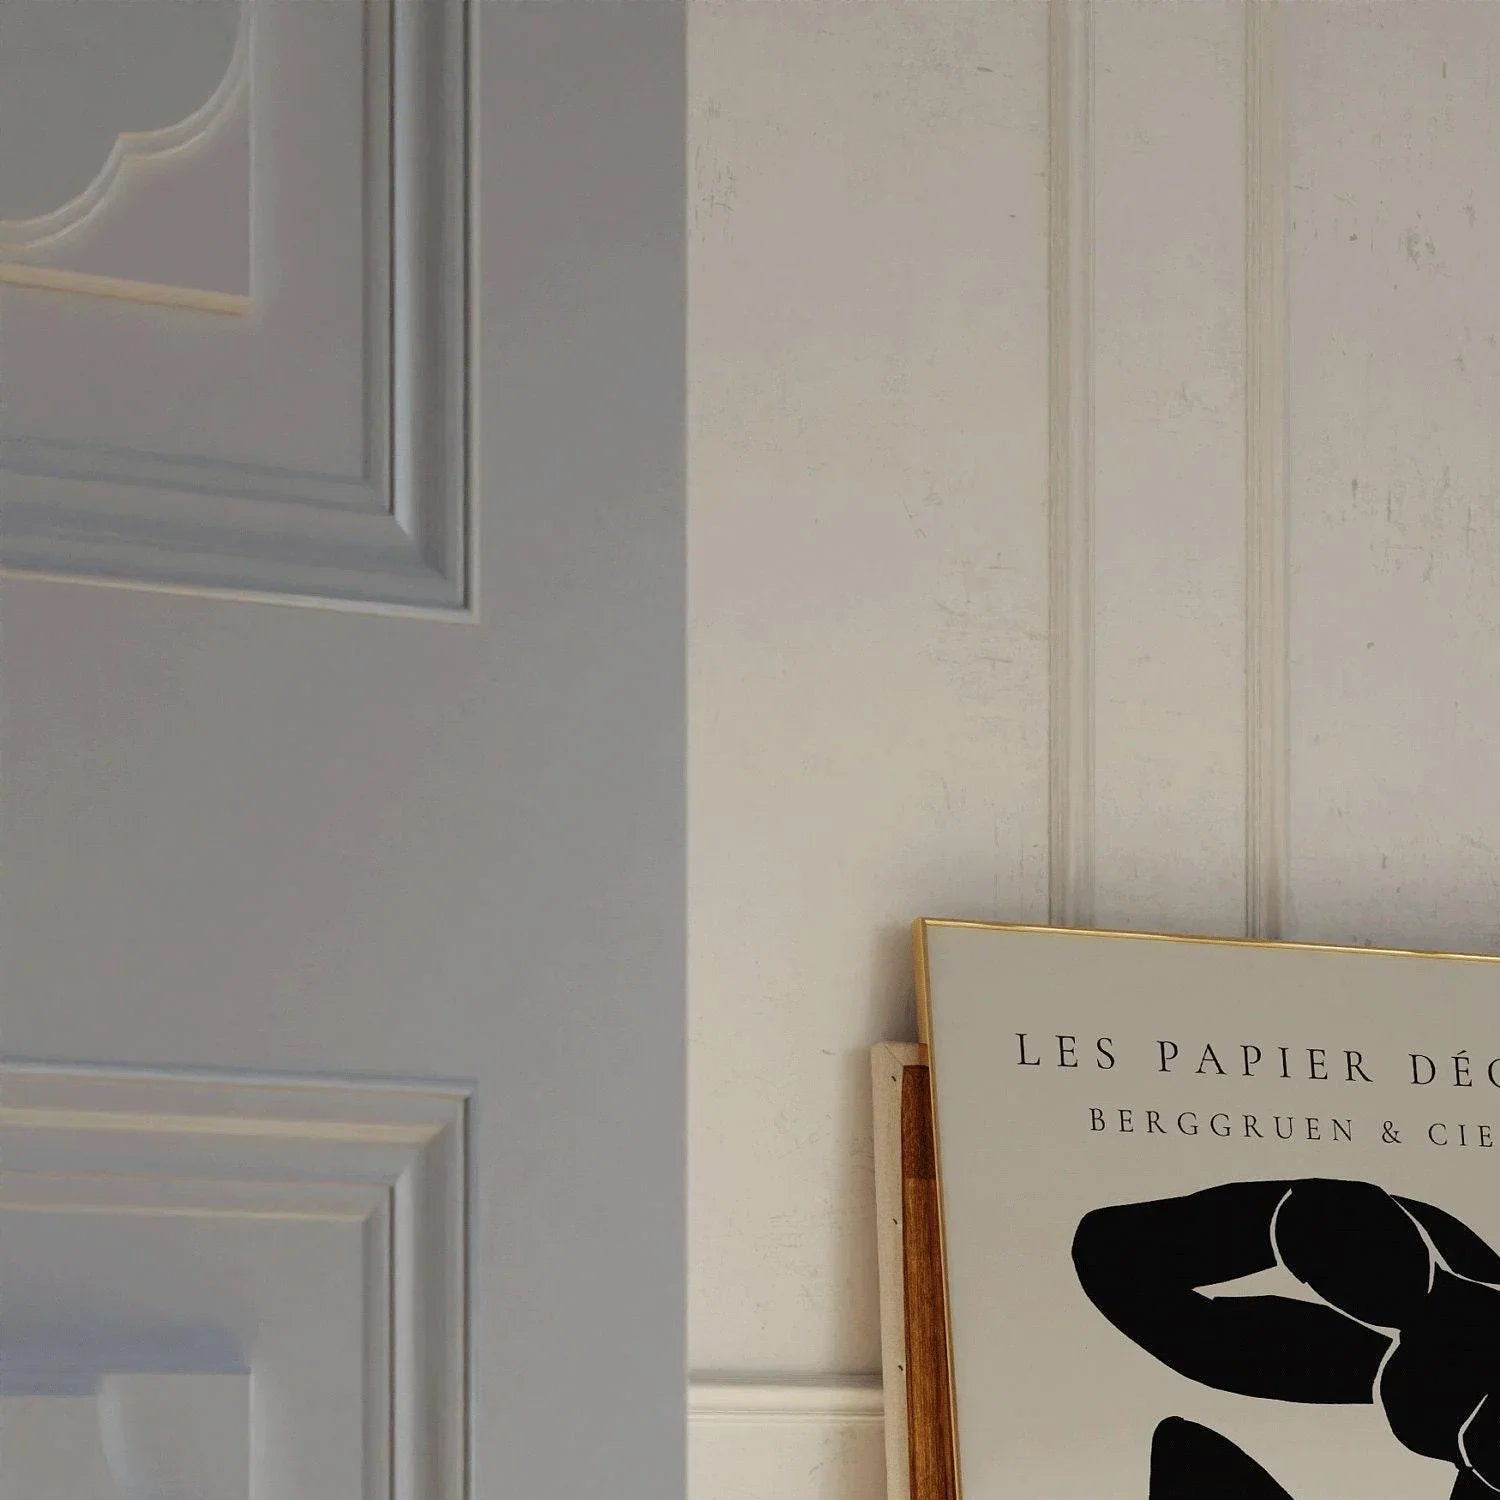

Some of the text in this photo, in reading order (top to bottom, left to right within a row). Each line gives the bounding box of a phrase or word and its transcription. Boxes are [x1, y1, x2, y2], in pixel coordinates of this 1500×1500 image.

[1015, 1032, 1117, 1070] LES
[1156, 1040, 1375, 1083] PAPIER
[1088, 1107, 1353, 1142] BERGGRUEN
[1381, 1119, 1403, 1144] &
